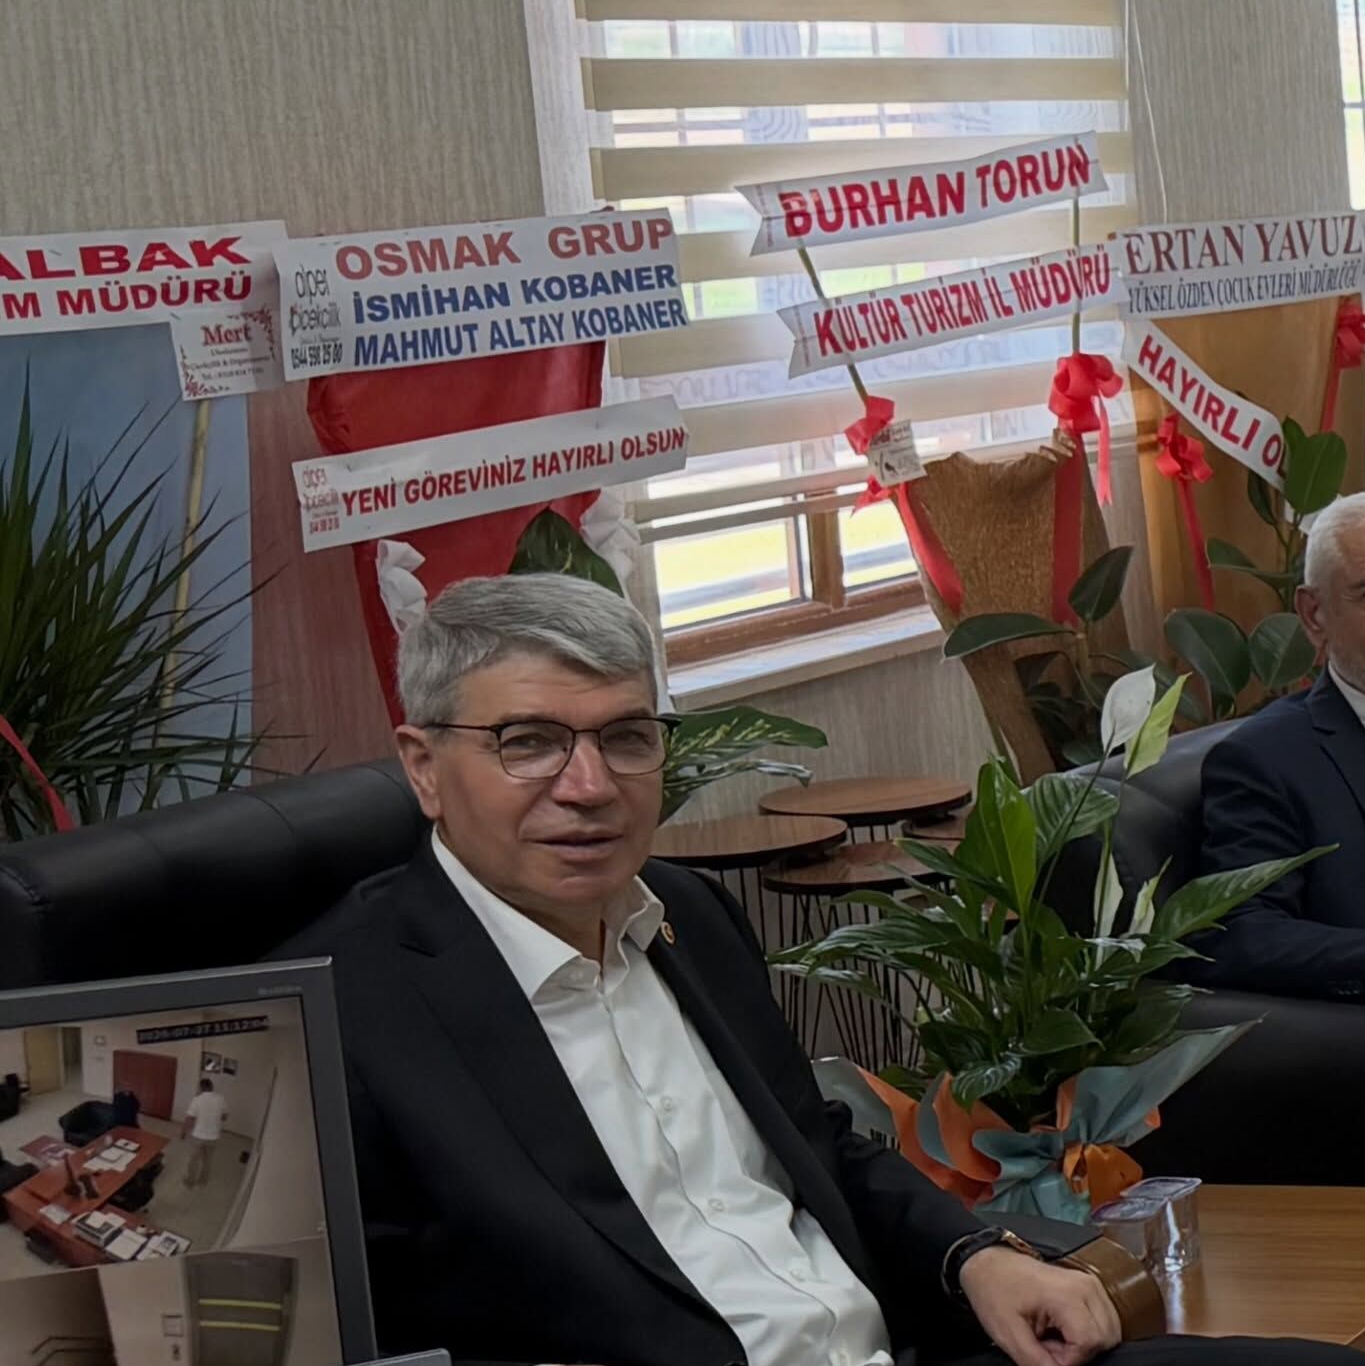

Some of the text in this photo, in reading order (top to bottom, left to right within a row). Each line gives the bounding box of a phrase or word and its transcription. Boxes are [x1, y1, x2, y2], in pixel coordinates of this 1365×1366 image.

[778, 171, 966, 238] BURHAN
[975, 143, 1091, 208] TORUN
[336, 217, 675, 281] OSMAK GRUP
[1125, 224, 1245, 276] ERTAN
[1255, 215, 1363, 263] YAVUZ
[56, 270, 252, 316] MÜDÜRÜ
[353, 263, 678, 325] İSMİHAN KOBANER
[813, 244, 1111, 358] KÜLTÜR TURİZM İL MÜDÜRÜ
[1128, 280, 1175, 314] YÜKSEL
[1177, 277, 1216, 309] ÖZDEN
[1217, 275, 1255, 308] ÇOCUK
[1257, 267, 1298, 301] EVLERİ
[202, 323, 252, 347] Mert
[353, 297, 688, 367] MAHMUT ALTAY KOBANER
[1138, 333, 1262, 452] HAYIRLI
[342, 477, 398, 517] YENİ
[404, 453, 526, 505] GÖREVİNİZ
[532, 440, 615, 479] HAYIRLI
[620, 426, 686, 462] OLSUN
